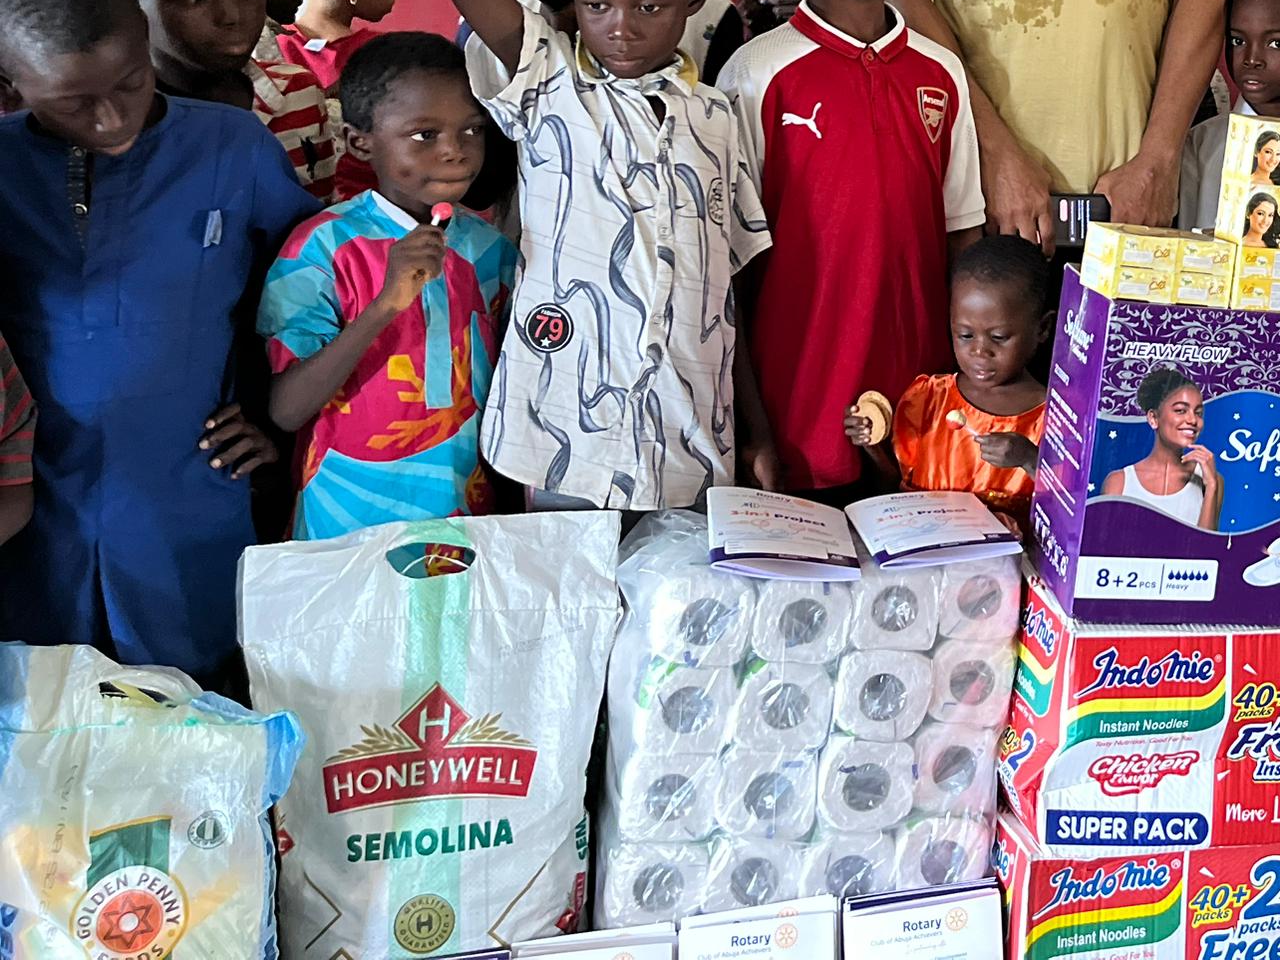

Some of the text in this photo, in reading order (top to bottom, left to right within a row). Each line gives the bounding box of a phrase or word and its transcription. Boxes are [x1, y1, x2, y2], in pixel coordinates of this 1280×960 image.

[534, 315, 563, 341] 79
[1123, 342, 1230, 363] HEAVY FLOW
[774, 513, 827, 528] Project
[917, 508, 968, 517] Project
[1074, 648, 1214, 699] Indomie
[419, 703, 450, 740] H
[1237, 706, 1273, 719] packs
[1100, 717, 1189, 733] Instant Noodles
[1092, 753, 1197, 776] Chicken
[333, 756, 522, 801] HONEYWELL
[1226, 803, 1267, 822] More
[348, 818, 513, 862] SEMOLINA
[1056, 816, 1198, 841] SUPER PACK
[1033, 860, 1170, 920] Indomie
[77, 874, 129, 939] GOLDEN
[137, 872, 181, 925] PENNY
[1194, 908, 1231, 922] packs
[903, 918, 941, 932] Rotary
[731, 934, 771, 947] Rotary
[1057, 926, 1146, 949] Instant Noodles
